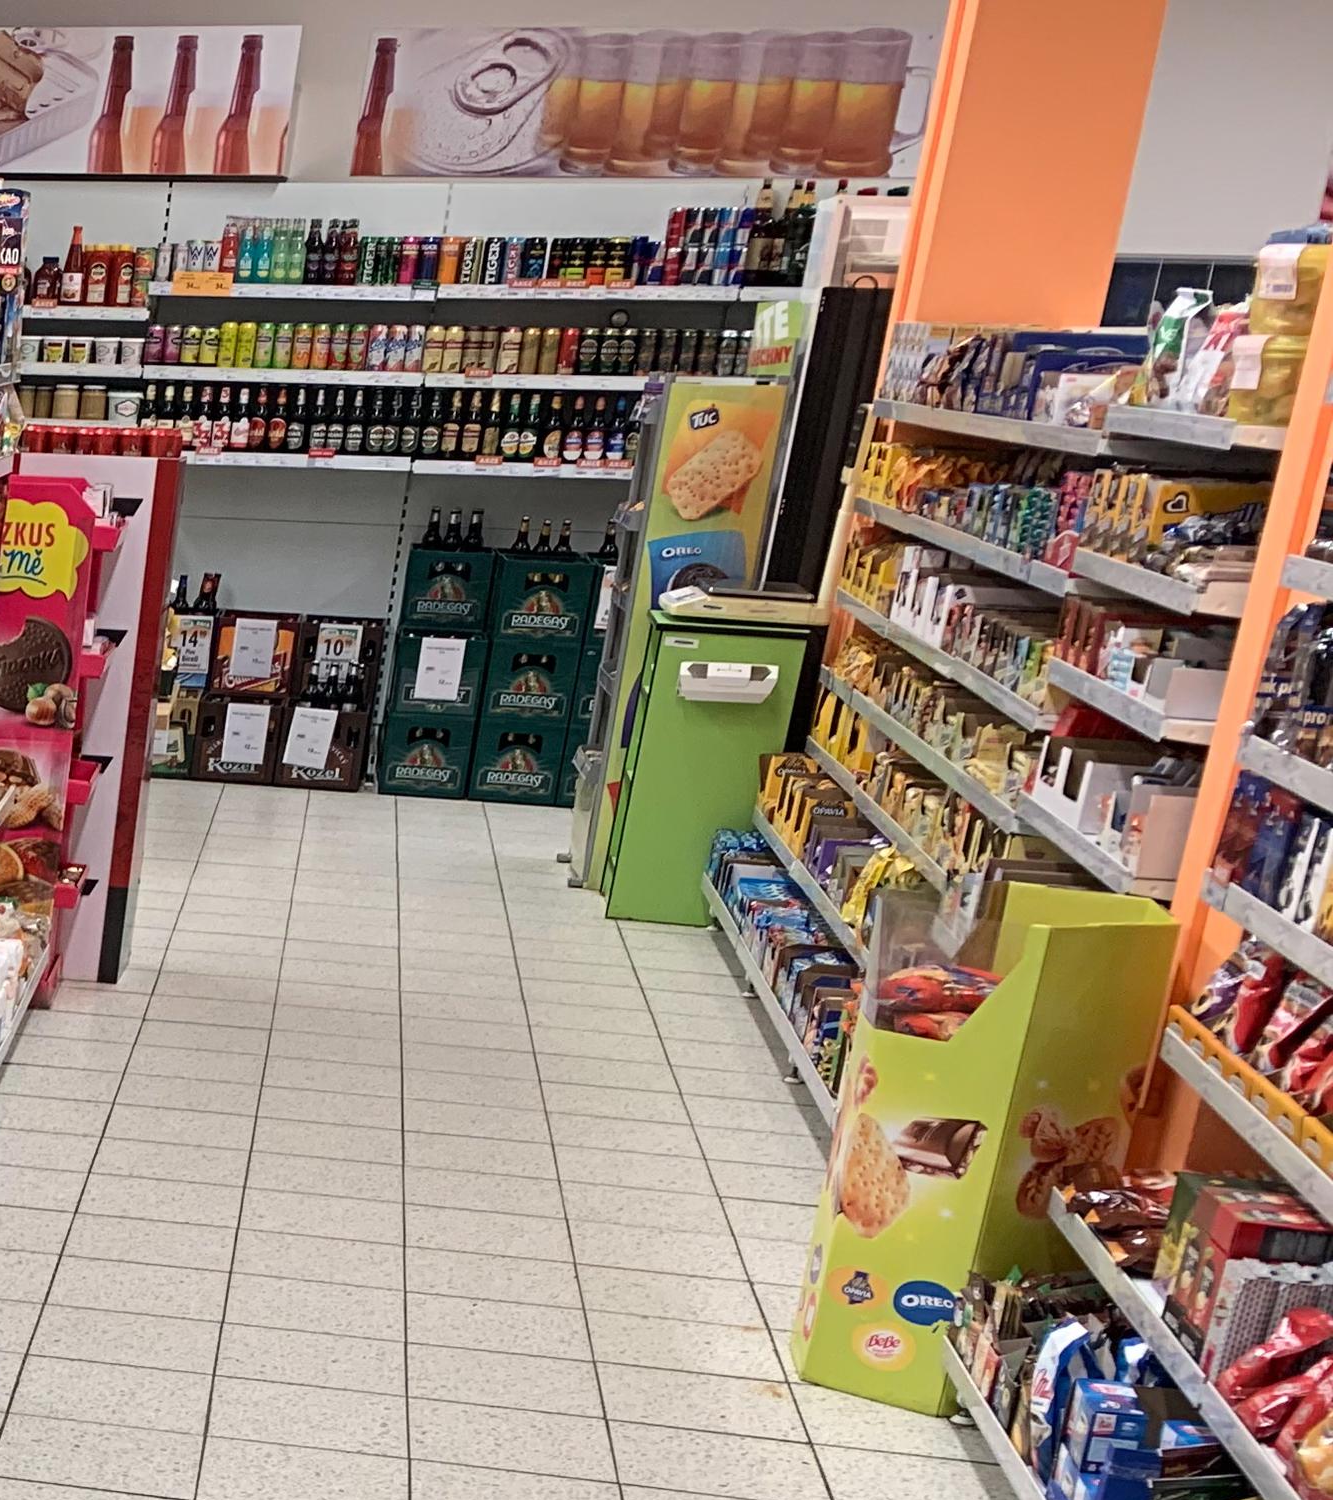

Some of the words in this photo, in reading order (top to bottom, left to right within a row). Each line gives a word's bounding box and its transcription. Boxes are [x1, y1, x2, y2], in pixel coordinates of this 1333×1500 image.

[362, 243, 376, 284] TIGER
[462, 243, 474, 284] TIGER
[486, 242, 501, 284] TIGER
[690, 410, 718, 428] TUC
[2, 522, 56, 548] ZKUS
[661, 545, 702, 558] OREO
[510, 615, 570, 630] RADEGAST
[181, 631, 200, 648] 14
[323, 638, 345, 656] 10
[499, 694, 558, 709] RADEGAST
[396, 766, 452, 782] RADEGAST
[487, 771, 545, 788] RADEGAST
[843, 1285, 872, 1299] OPAVIA
[900, 1294, 955, 1309] OREO
